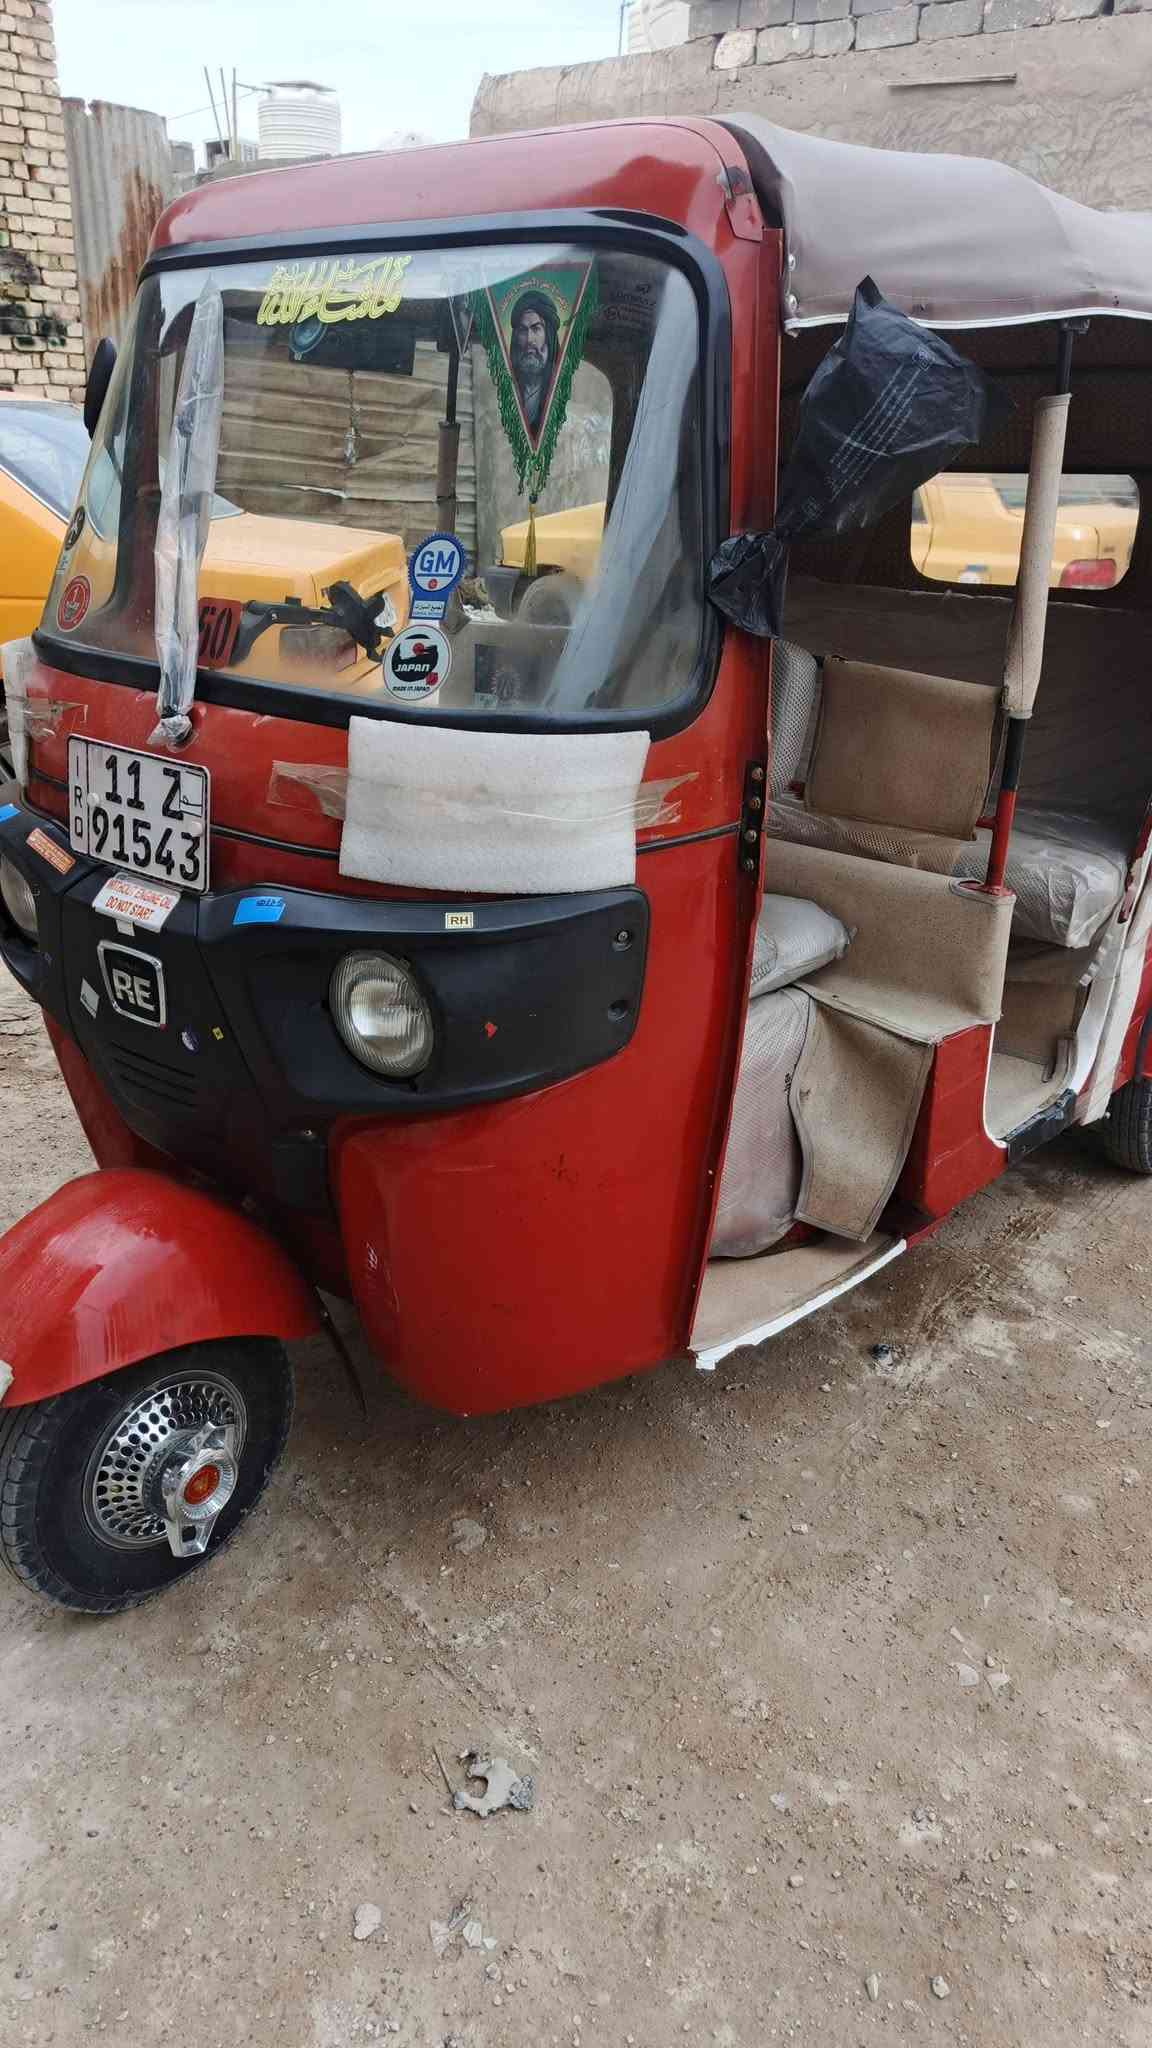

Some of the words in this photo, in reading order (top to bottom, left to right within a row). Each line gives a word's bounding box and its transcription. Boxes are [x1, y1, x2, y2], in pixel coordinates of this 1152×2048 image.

[419, 550, 456, 573] GM
[395, 663, 430, 672] JAPAN
[105, 755, 145, 811] 11
[162, 767, 184, 821] Z
[92, 806, 200, 882] 91543
[129, 904, 155, 919] START
[450, 916, 469, 925] RH
[112, 968, 155, 1012] RE
